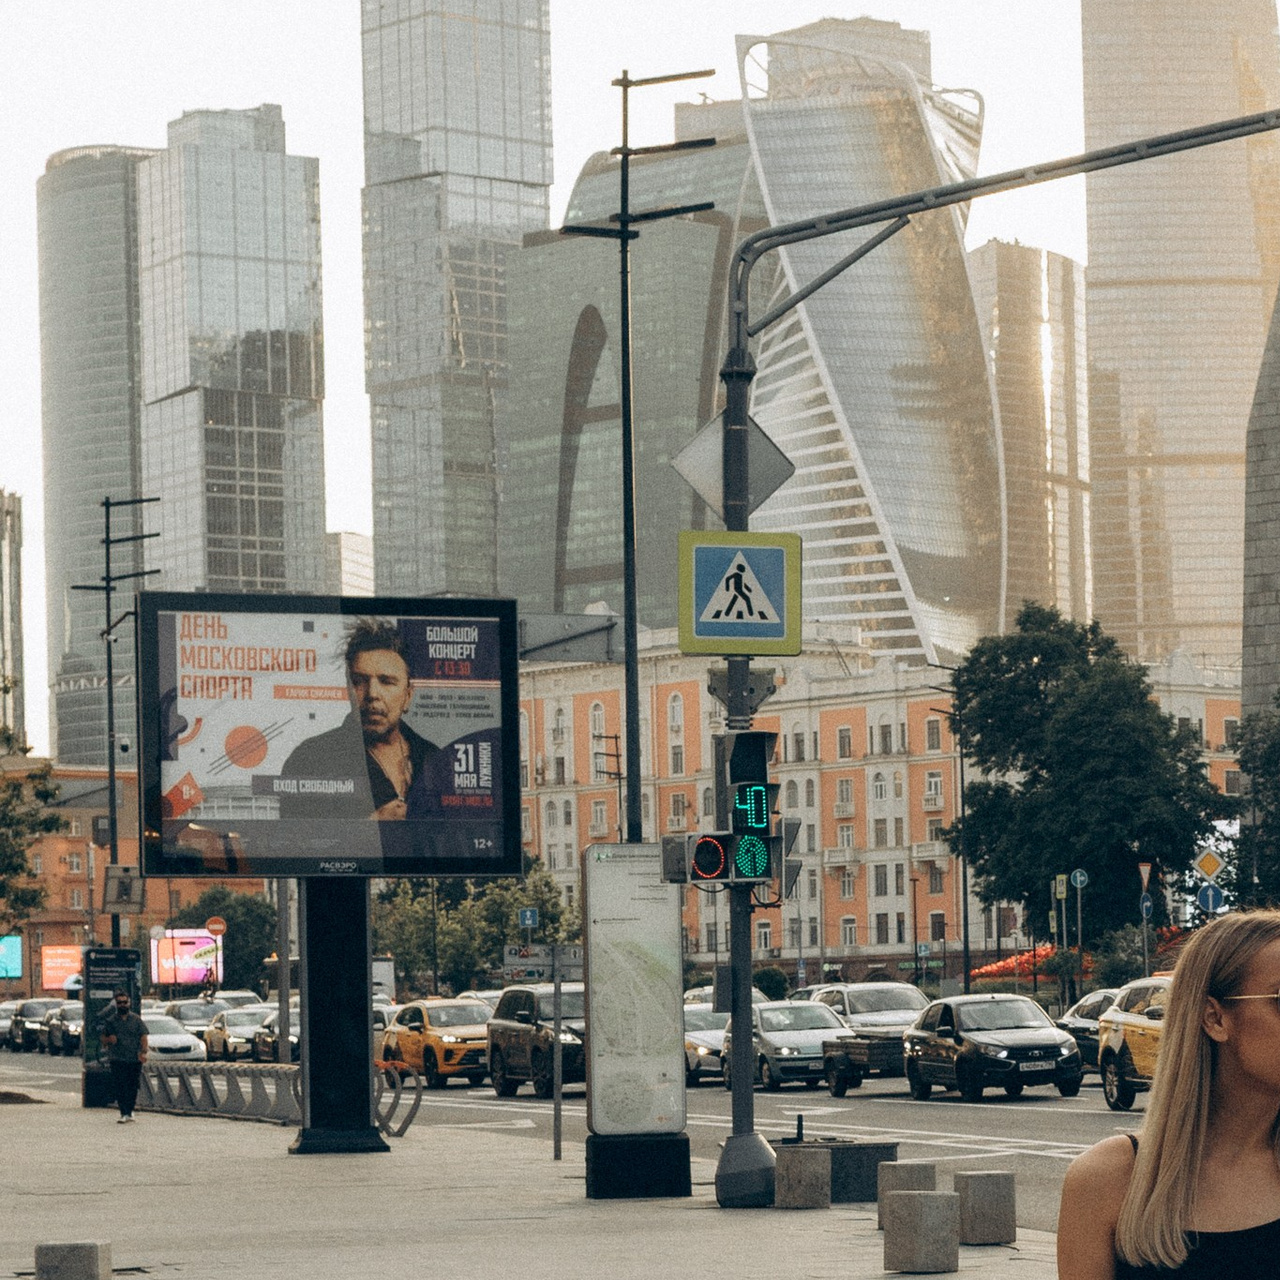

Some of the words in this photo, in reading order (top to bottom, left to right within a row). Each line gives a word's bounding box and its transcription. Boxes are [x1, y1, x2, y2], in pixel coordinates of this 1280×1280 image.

[180, 614, 228, 641] ДЕНЬ
[426, 625, 479, 642] БОЛЬШОЙ
[180, 644, 317, 673] МОСКОВСКОГО
[428, 643, 477, 660] КОНЦЕРТ
[180, 674, 253, 700] СПОРТА
[454, 743, 475, 773] 31
[478, 742, 492, 788] ЛУЖНИКИ
[272, 779, 298, 794] ВХОД
[299, 778, 355, 794] СВОБОДНЫЙ
[454, 773, 477, 788] МАЯ
[735, 786, 767, 828] 40
[473, 838, 494, 850] 12+
